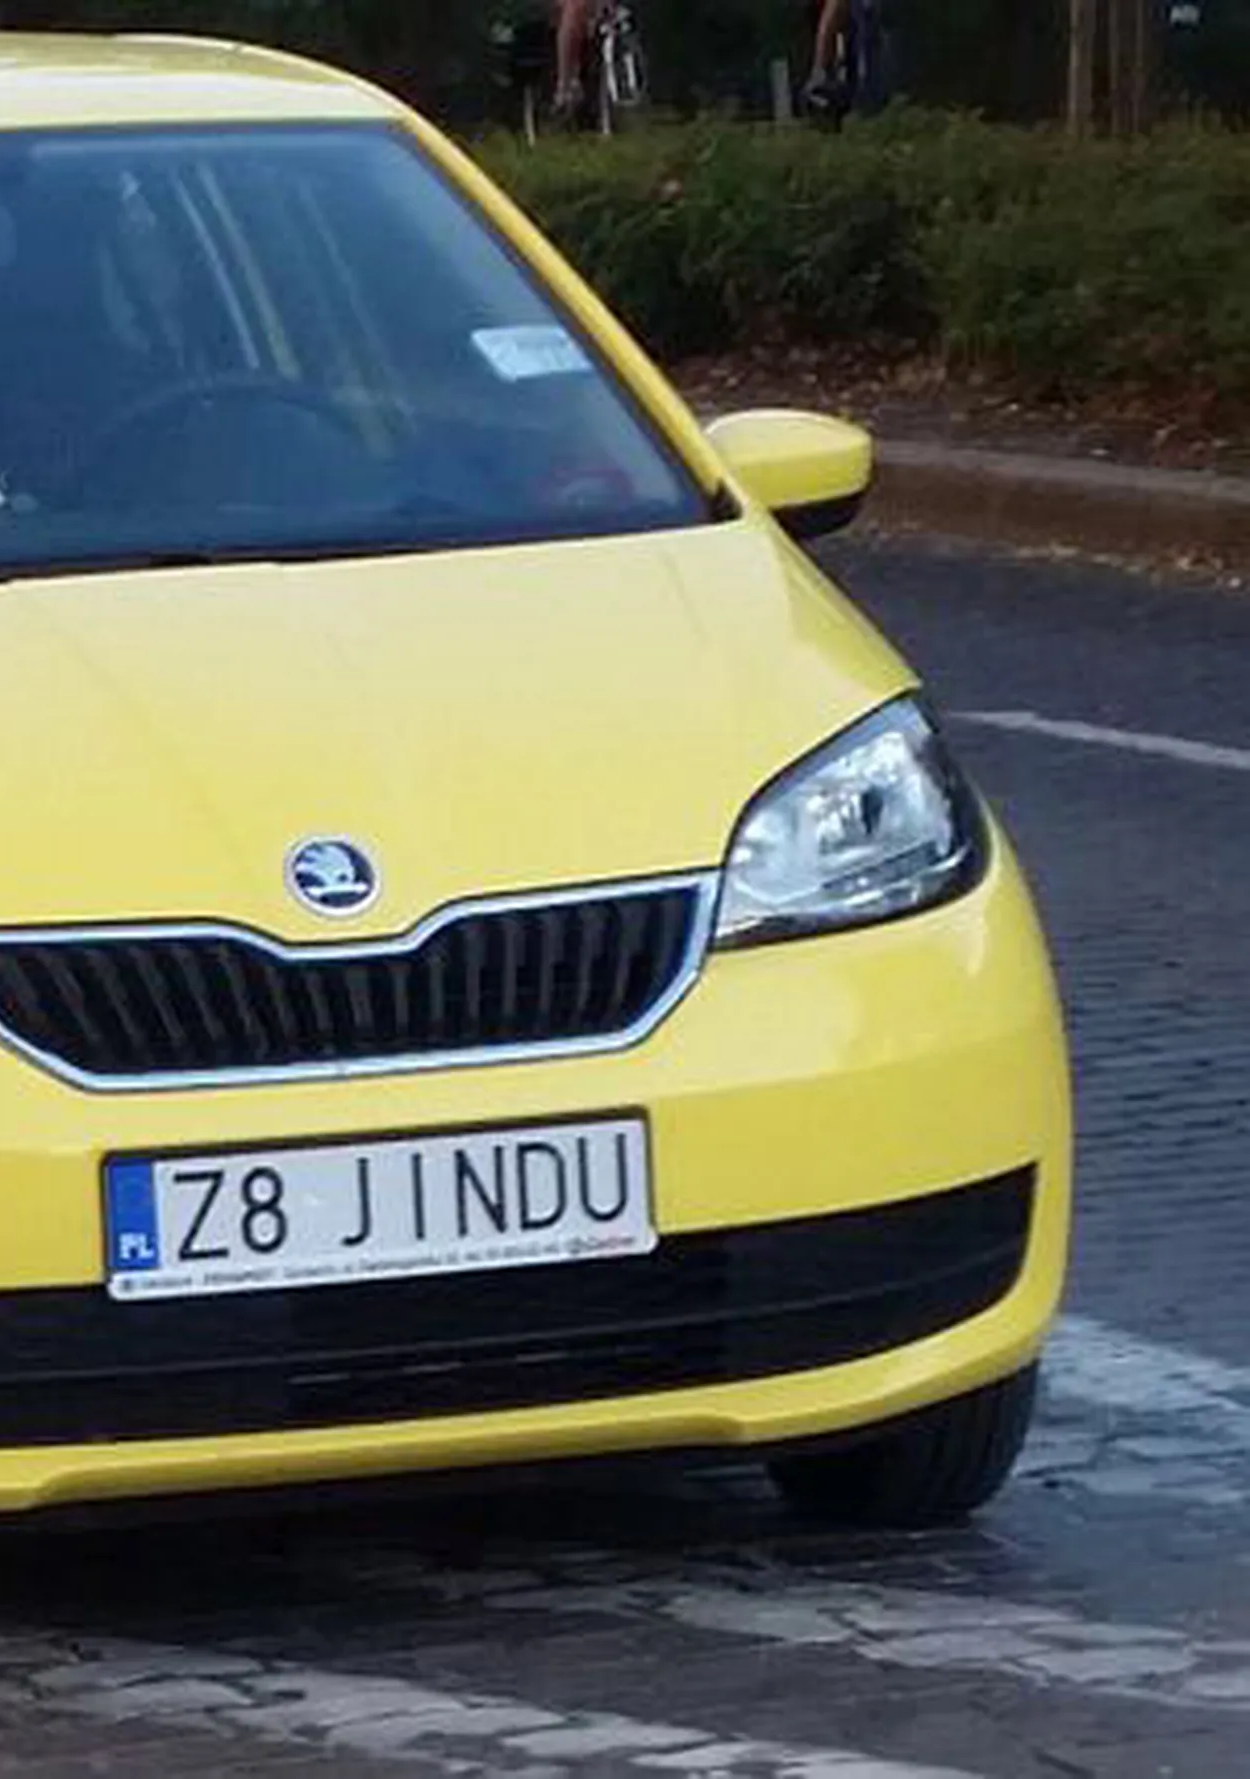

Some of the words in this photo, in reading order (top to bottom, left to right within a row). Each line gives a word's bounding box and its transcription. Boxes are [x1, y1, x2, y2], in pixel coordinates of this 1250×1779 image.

[171, 1166, 288, 1261] Z8
[340, 1132, 629, 1247] JINDU
[119, 1232, 155, 1259] PL
